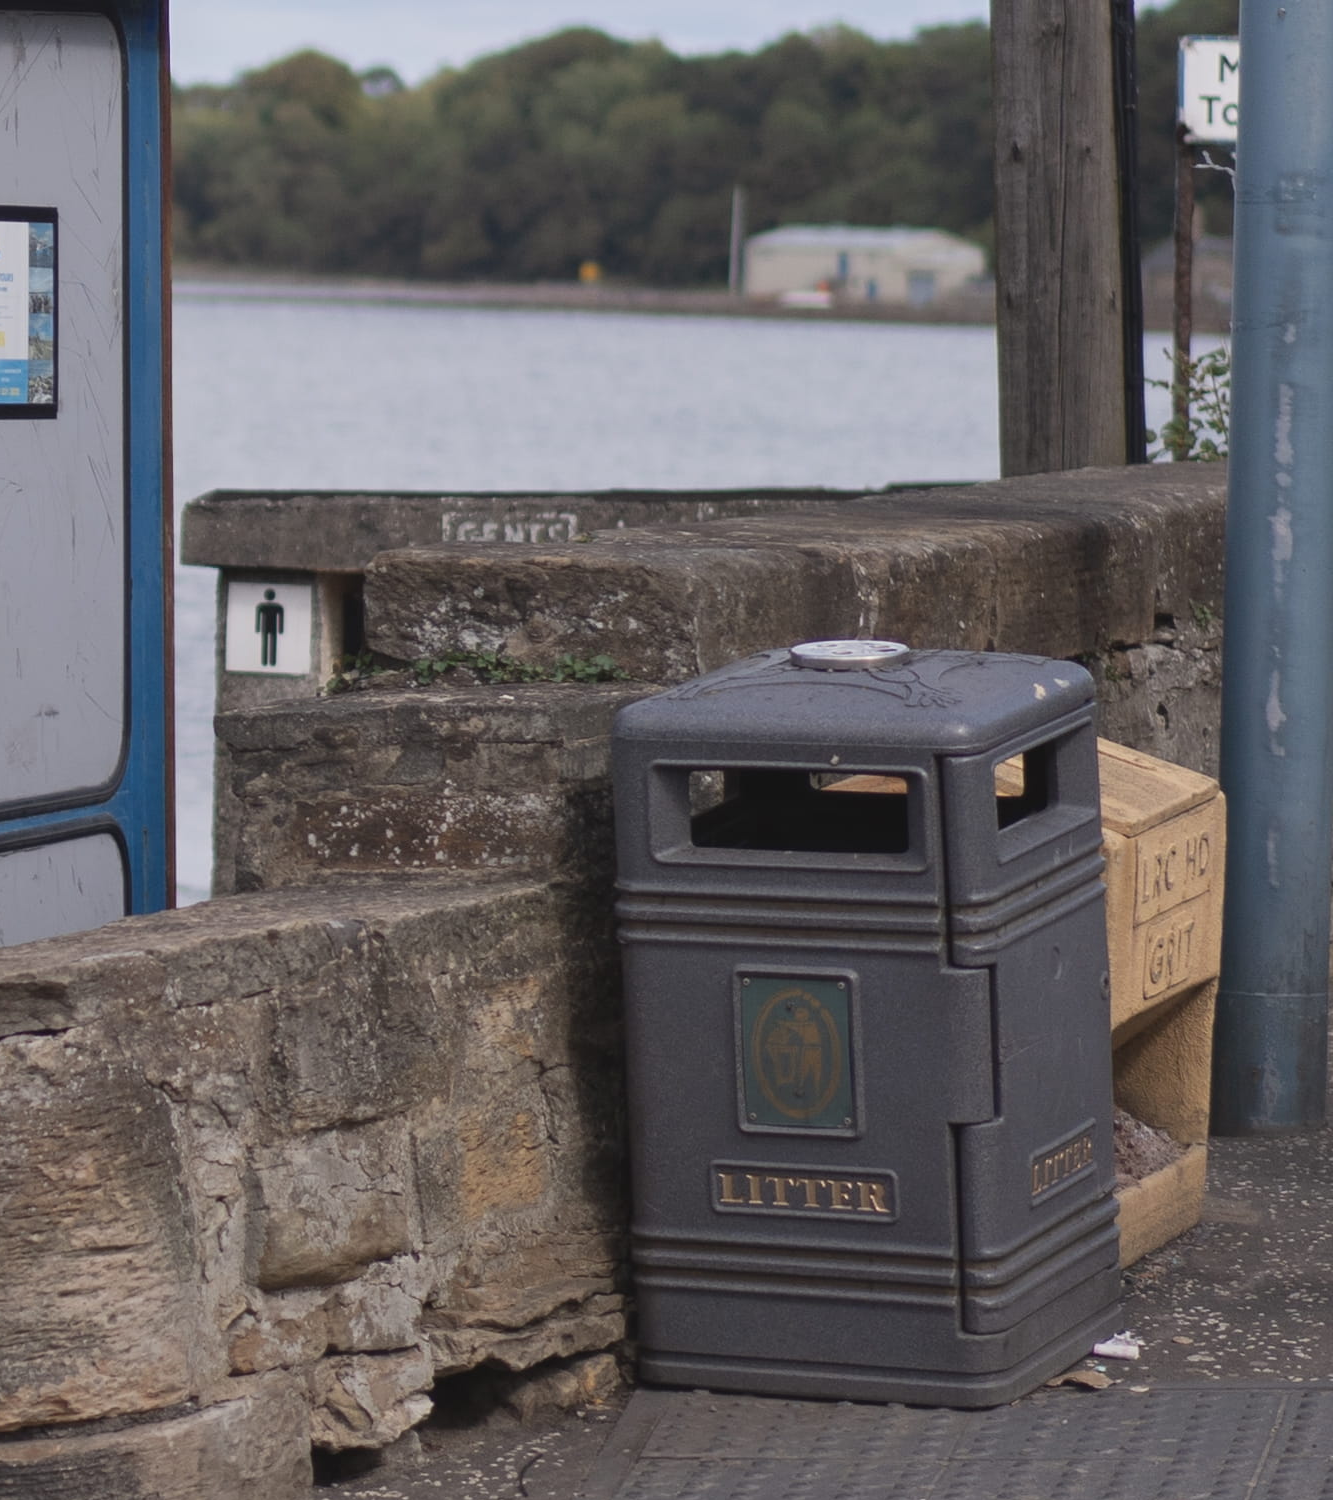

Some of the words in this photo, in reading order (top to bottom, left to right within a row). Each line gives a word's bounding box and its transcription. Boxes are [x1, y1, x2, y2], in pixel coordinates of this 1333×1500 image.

[1184, 832, 1210, 884] HD
[1149, 920, 1195, 984] GRIT
[717, 1172, 890, 1213] LITTER
[1030, 1136, 1093, 1196] LITTER
